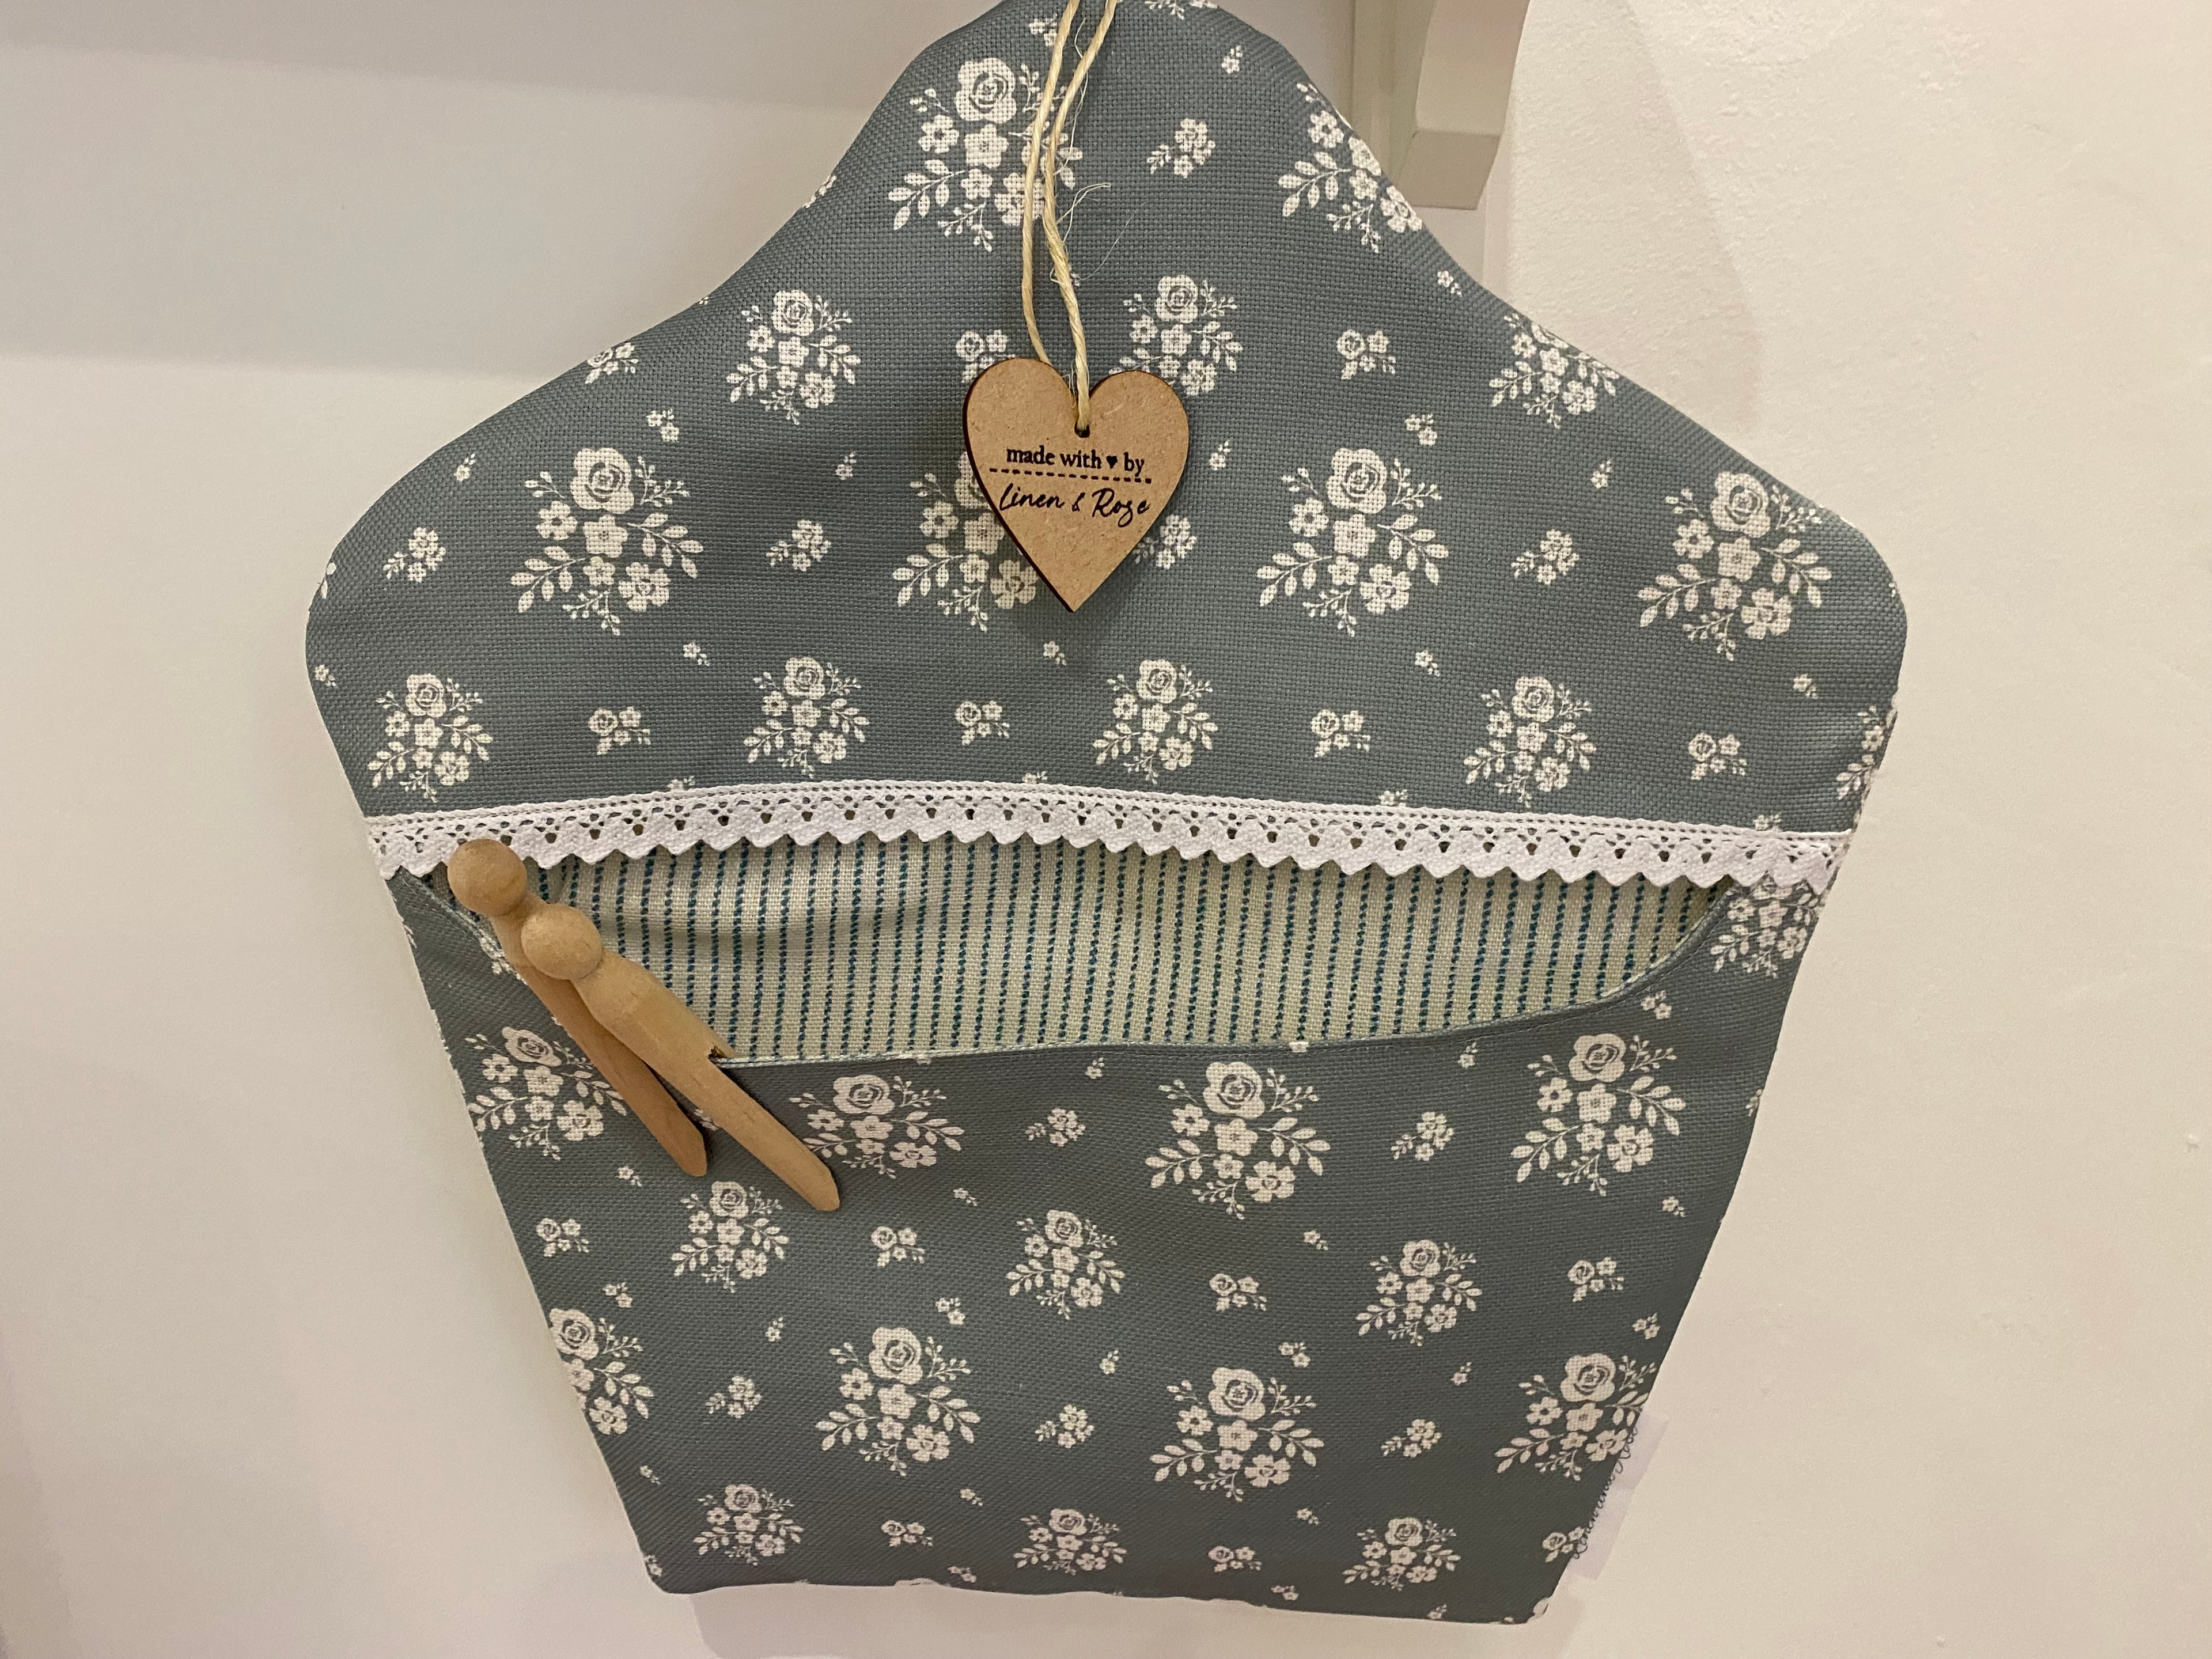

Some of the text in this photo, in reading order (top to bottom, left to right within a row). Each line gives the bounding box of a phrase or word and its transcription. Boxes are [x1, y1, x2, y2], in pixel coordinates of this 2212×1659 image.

[1006, 445, 1145, 478] made with by
[999, 483, 1065, 512] Linen
